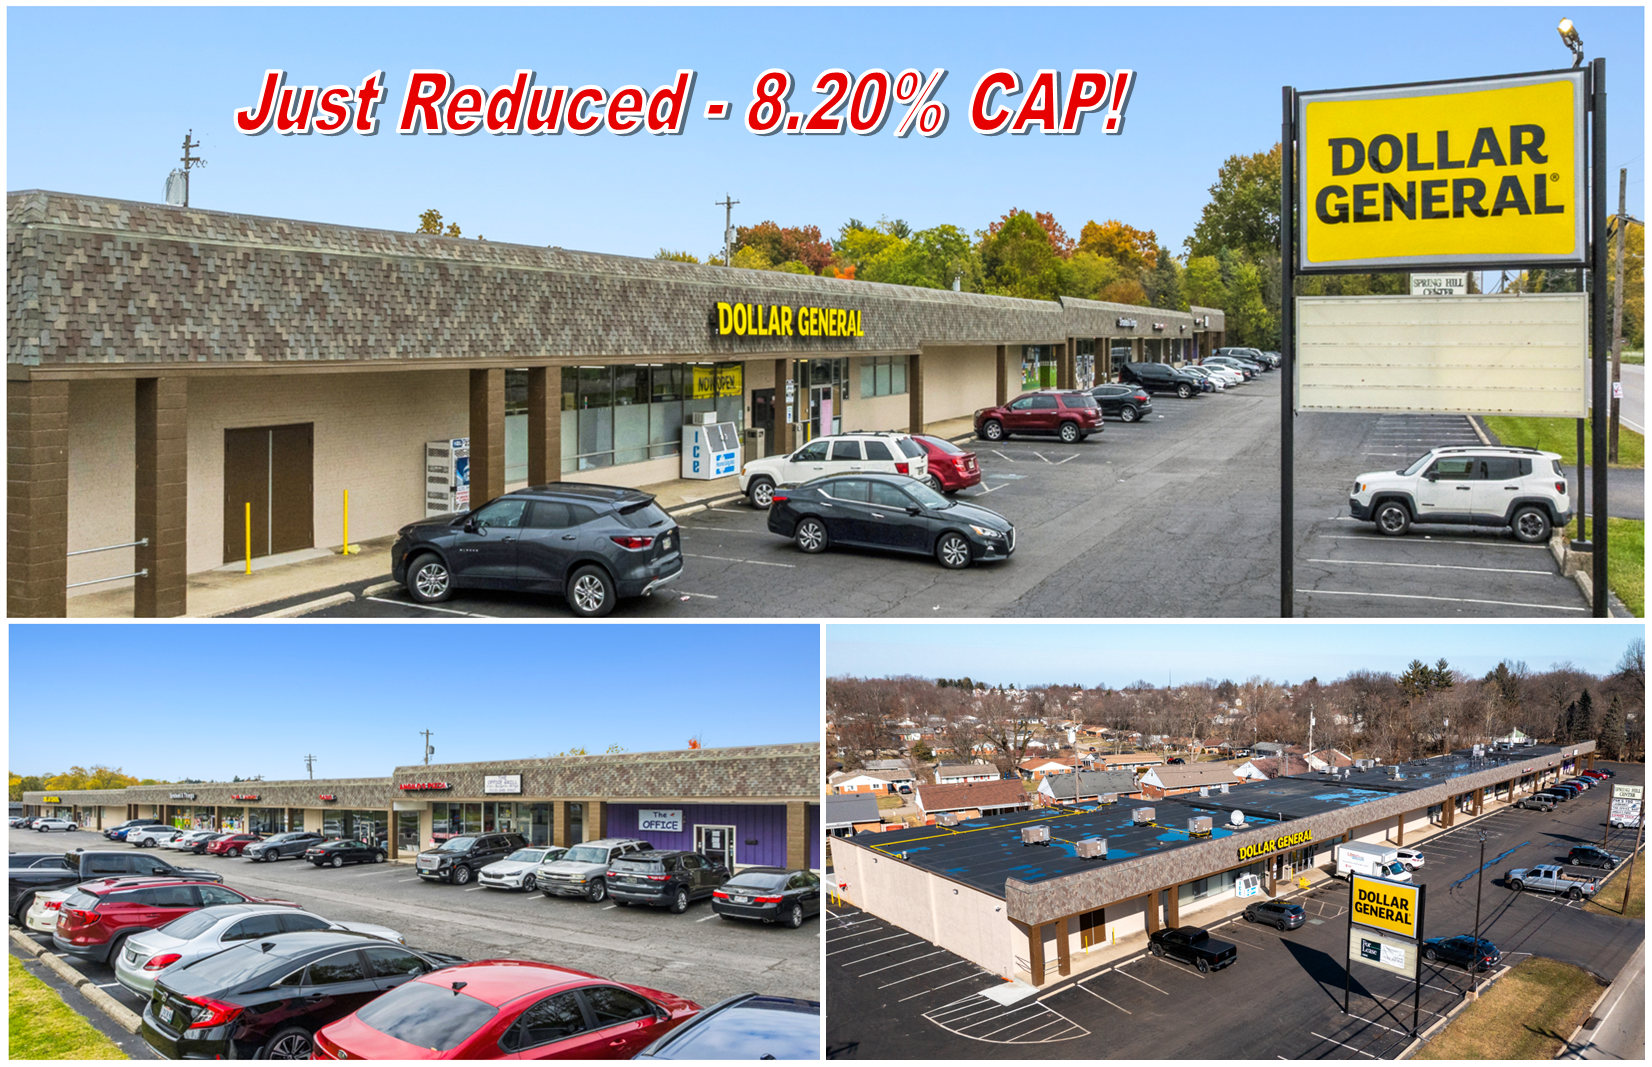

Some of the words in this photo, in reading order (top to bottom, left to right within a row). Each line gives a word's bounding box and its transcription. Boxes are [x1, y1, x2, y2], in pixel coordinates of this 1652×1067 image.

[1328, 124, 1548, 176] DOLLAR
[1315, 173, 1565, 225] GENERAL
[1413, 278, 1442, 288] SPRING
[1445, 278, 1464, 288] HILL
[717, 302, 793, 336] DOLLAR
[797, 306, 864, 337] GENERAL
[716, 375, 736, 391] OPEN
[427, 782, 448, 790] PIZZA
[642, 820, 678, 830] OFFICE
[1239, 839, 1276, 860] DOLLAR
[1277, 829, 1313, 849] GENERAL
[1358, 888, 1409, 911] DOLLAR
[1354, 901, 1412, 926] GENERAL
[1362, 939, 1372, 948] For
[1362, 944, 1378, 956] Lease
